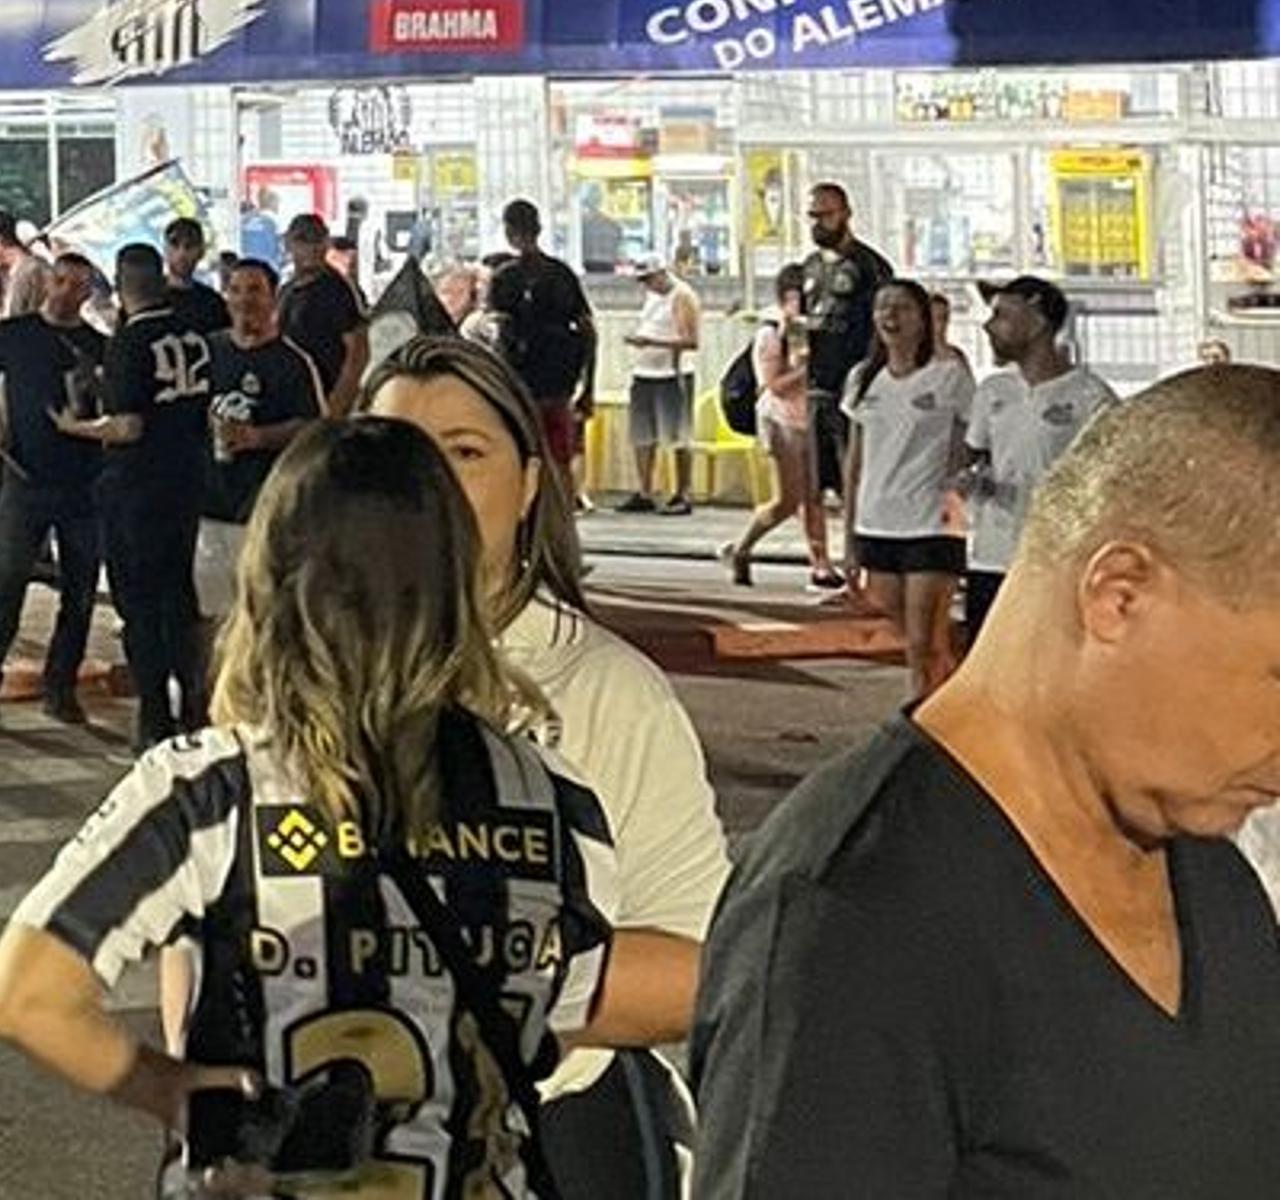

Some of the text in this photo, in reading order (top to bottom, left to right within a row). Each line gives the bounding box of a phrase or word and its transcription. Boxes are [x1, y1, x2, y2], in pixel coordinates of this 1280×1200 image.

[393, 9, 498, 42] BRAHMA
[712, 28, 775, 70] DO
[338, 820, 550, 864] BANCE
